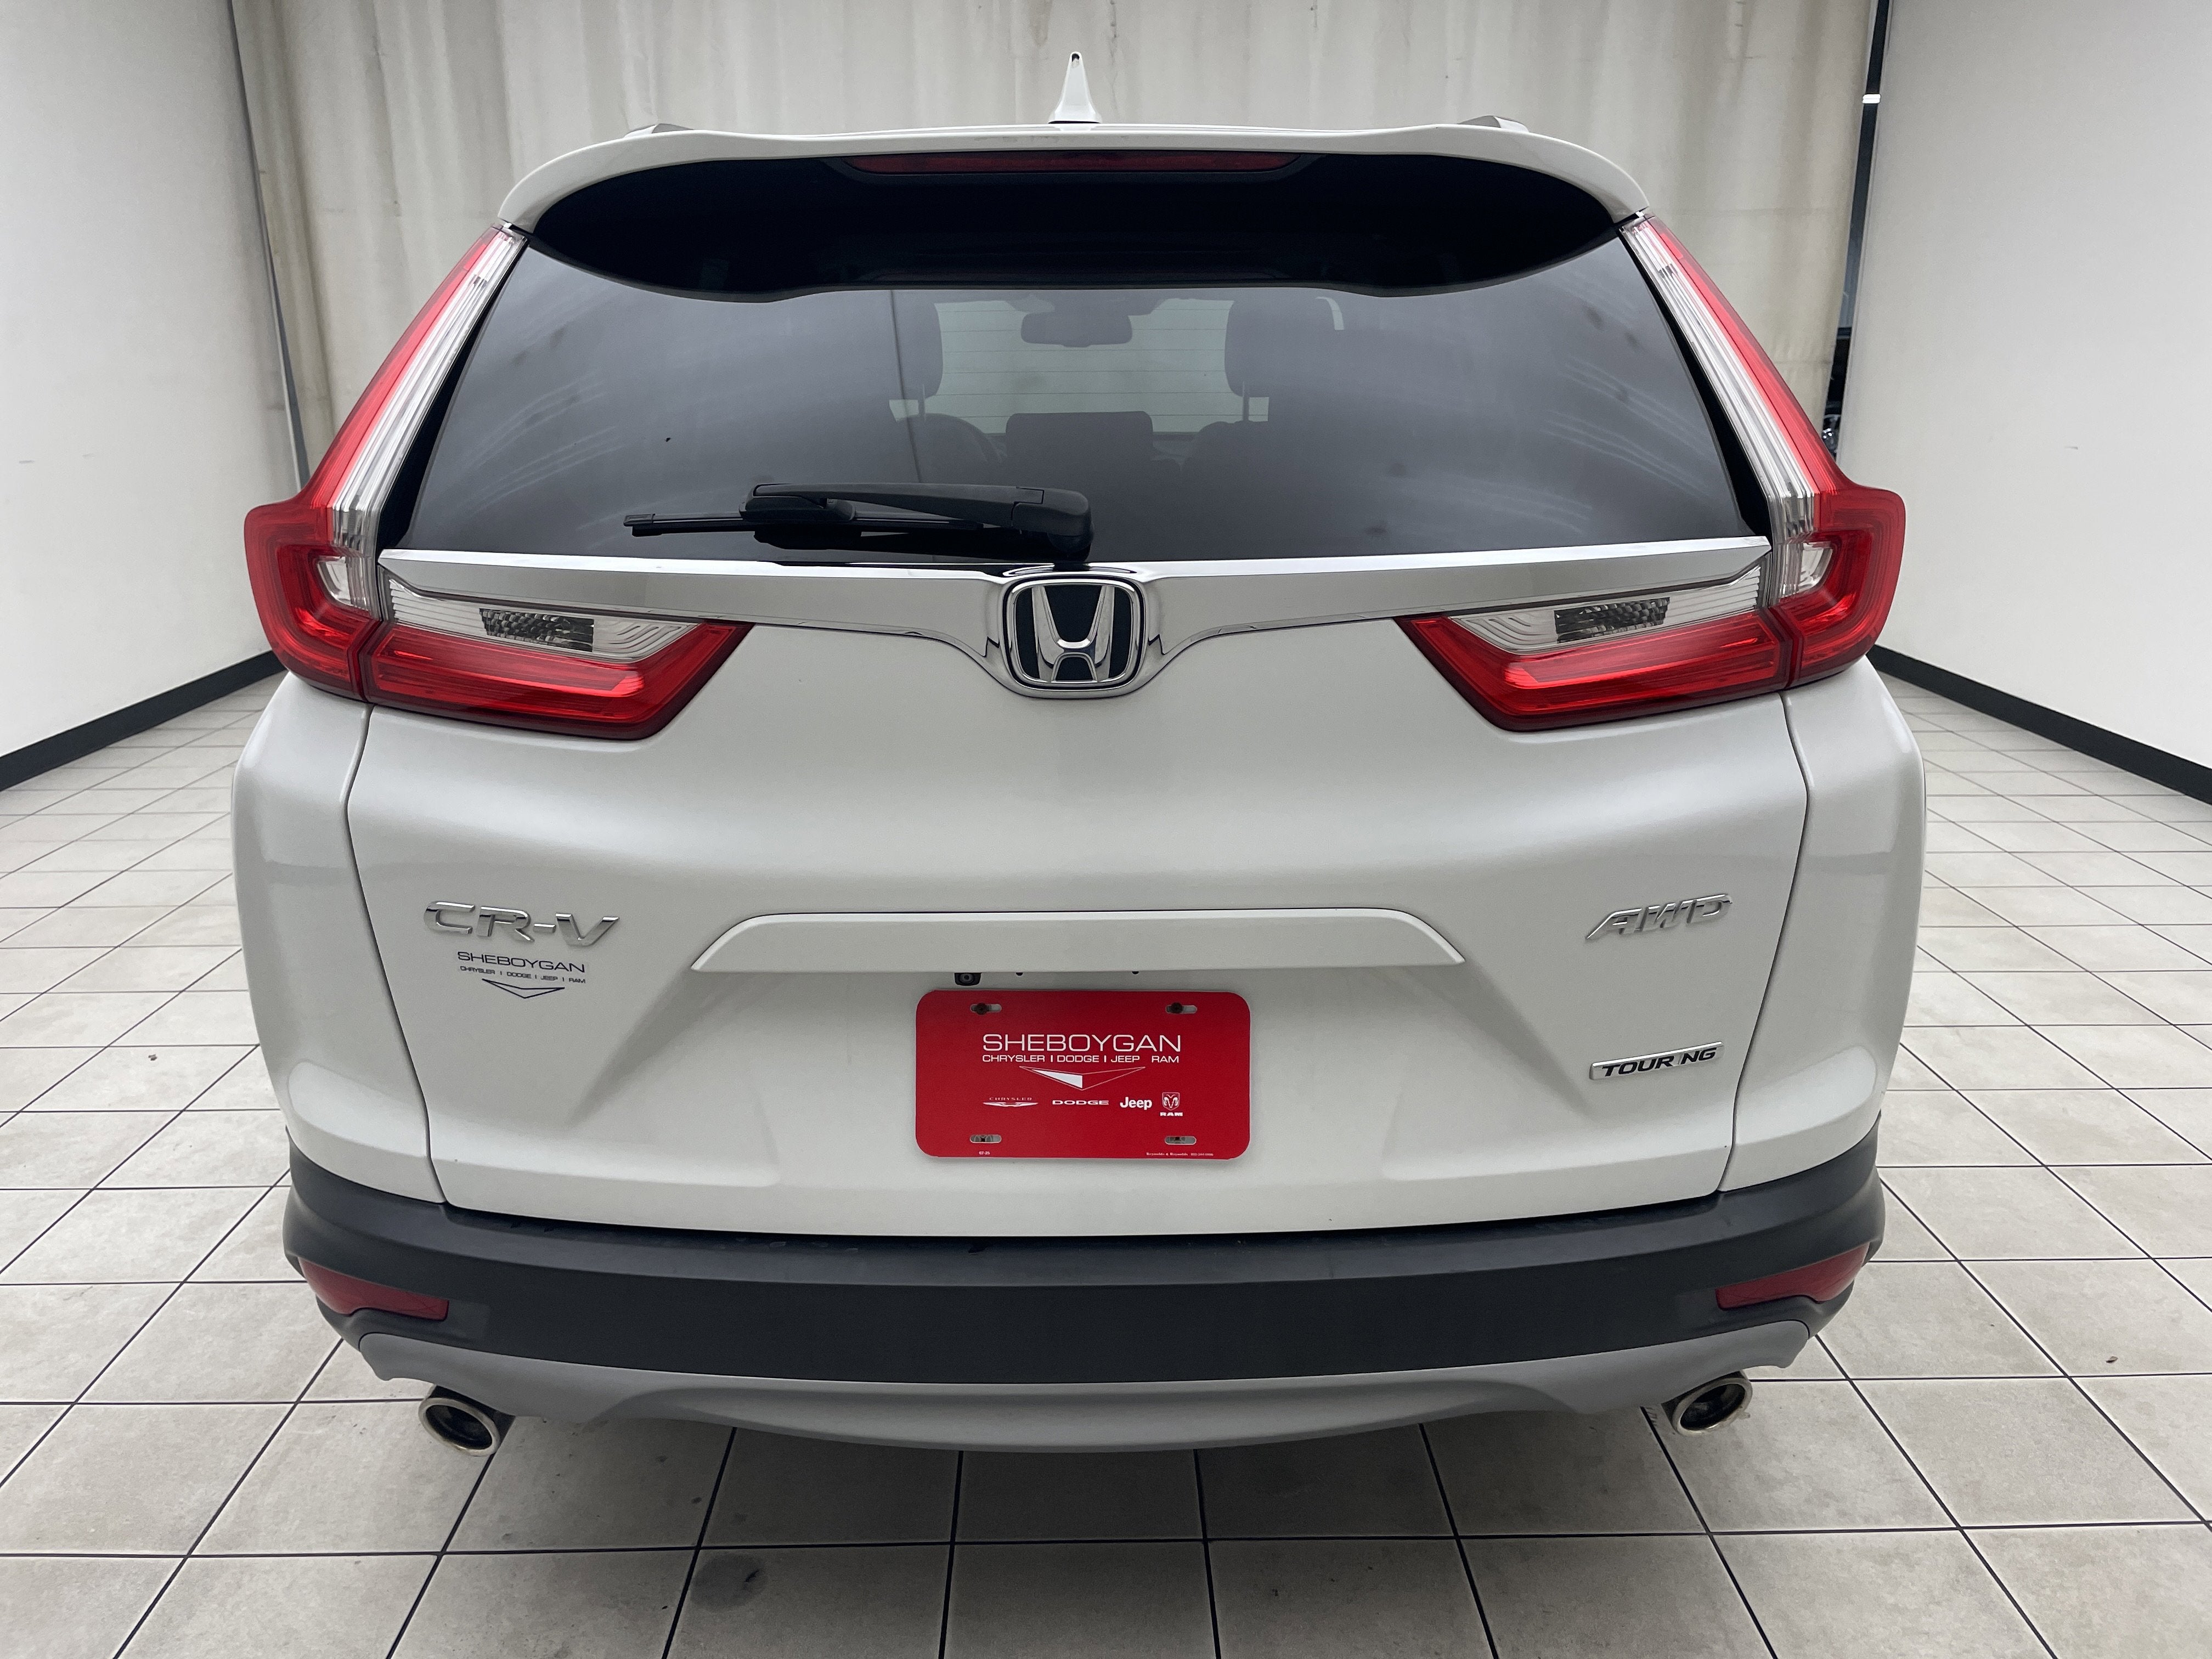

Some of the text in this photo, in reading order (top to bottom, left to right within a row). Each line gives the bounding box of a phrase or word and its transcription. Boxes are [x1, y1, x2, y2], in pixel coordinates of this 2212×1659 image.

[424, 901, 620, 947] CR-V
[1585, 894, 1733, 941] AWD
[458, 951, 585, 973] SHEBOYGAN
[460, 966, 495, 975] CHRYSLER
[983, 1034, 1181, 1052] SHEBOYGAN
[1120, 1097, 1153, 1110] Jeep
